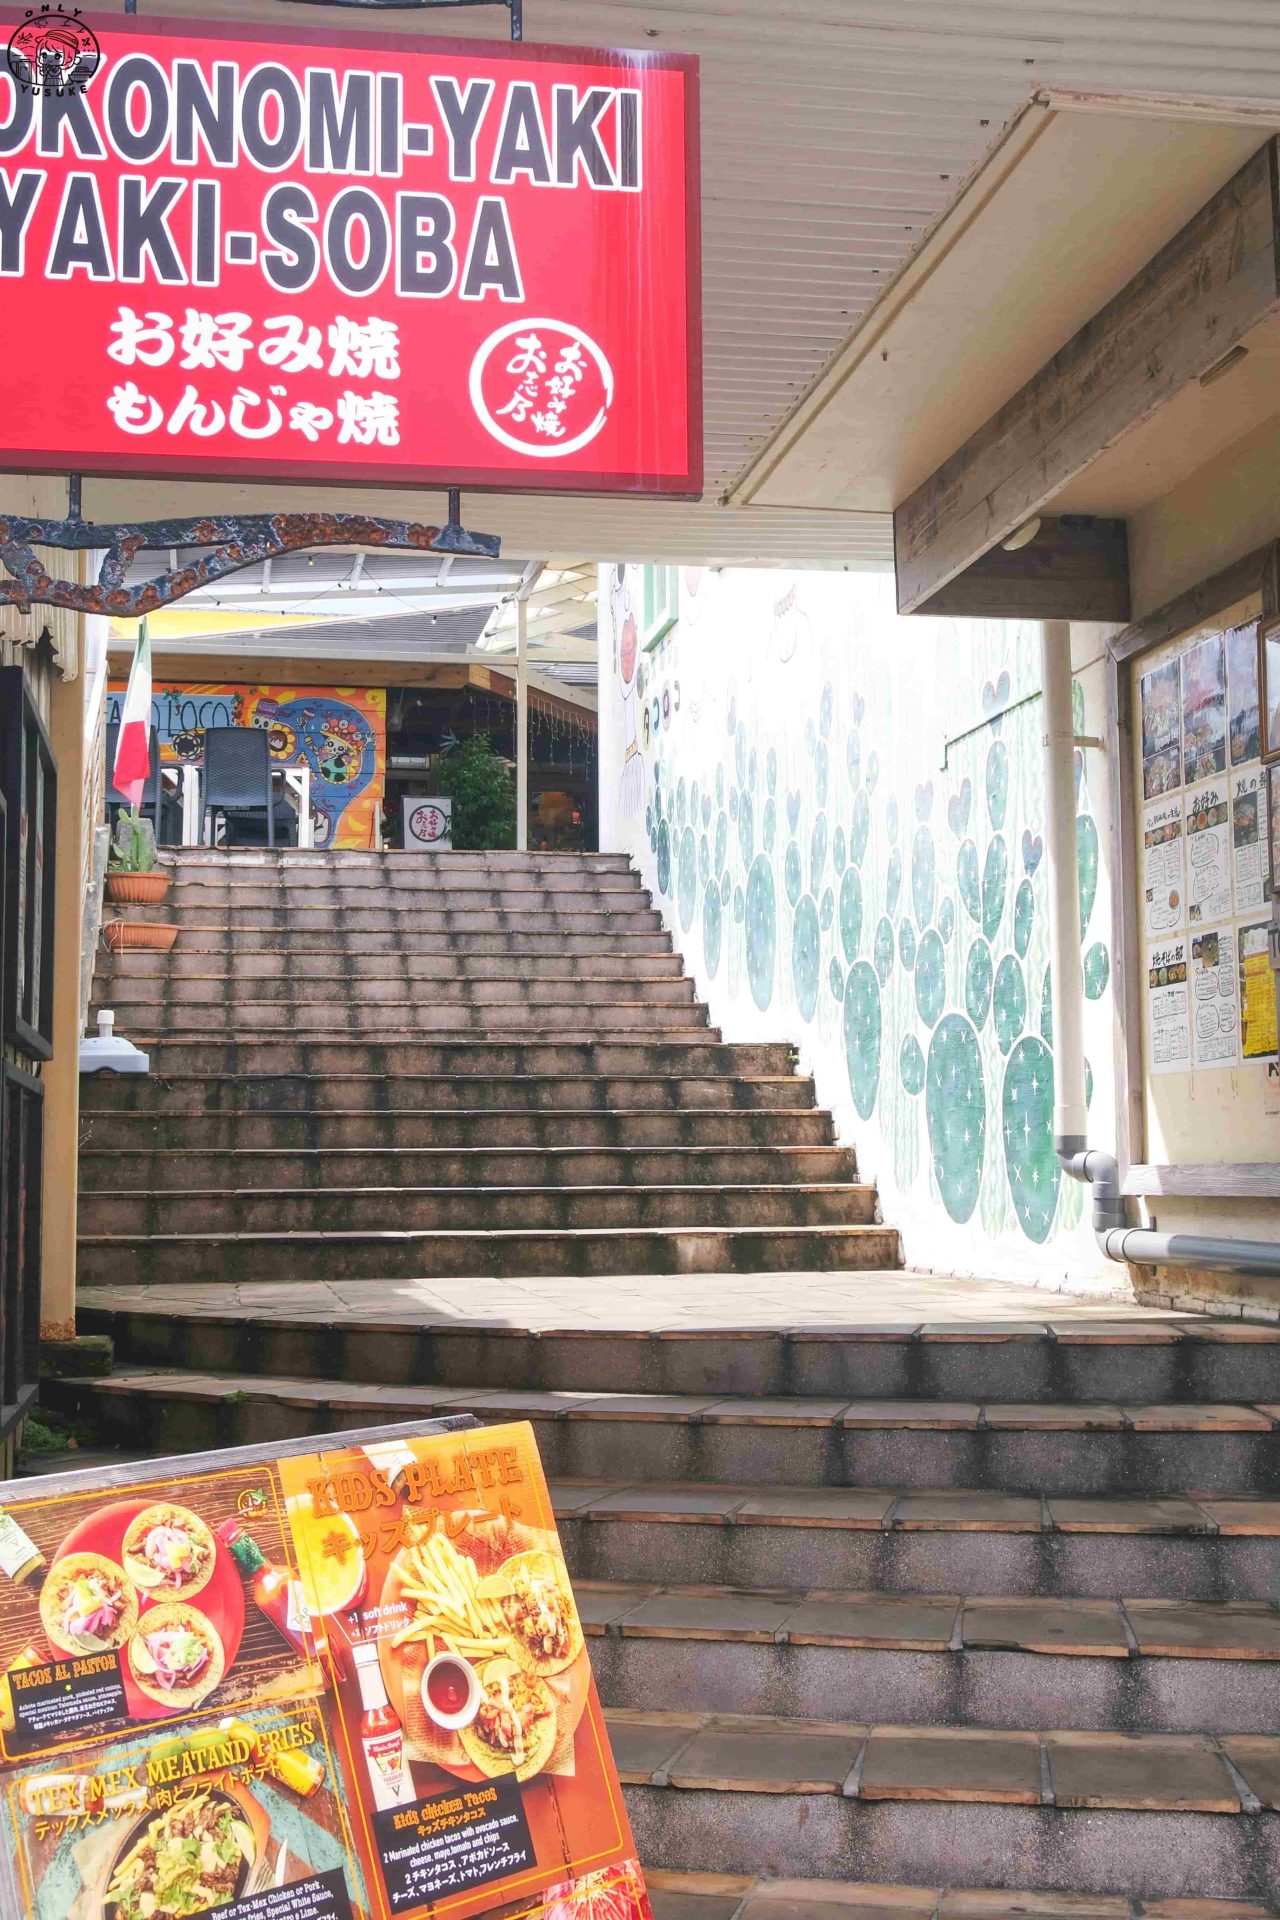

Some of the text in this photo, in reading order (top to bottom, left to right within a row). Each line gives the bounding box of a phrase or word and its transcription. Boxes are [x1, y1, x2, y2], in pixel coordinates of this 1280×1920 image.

[0, 166, 525, 303] YAKI-SOBA
[107, 306, 401, 380] お好み焼
[106, 381, 401, 446] もんじゃ焼
[306, 1448, 523, 1518] KIDS PLATE
[321, 1496, 521, 1566] キッズプレート
[362, 1606, 383, 1620] soft
[383, 1601, 408, 1614] drink
[12, 1654, 118, 1690] TACOS AL PASTOR
[28, 1720, 316, 1817] TEX-MEX MEATAND FRIES
[393, 1810, 420, 1830] Kids
[463, 1787, 498, 1807] Tacos
[417, 1807, 487, 1837] キッズチキンタコス
[383, 1852, 388, 1864] 2
[389, 1843, 420, 1862] Marinated
[420, 1836, 445, 1852] chicken
[445, 1831, 461, 1845] tacos
[462, 1826, 475, 1839] with
[475, 1818, 500, 1835] avocado
[472, 1838, 484, 1848] and
[484, 1831, 501, 1846] chips
[228, 1906, 237, 1917] or
[237, 1898, 268, 1915] Tex-Mex
[268, 1890, 296, 1908] Chicken
[296, 1886, 304, 1896] or
[266, 1901, 292, 1920] Special
[292, 1895, 312, 1909] White
[312, 1889, 334, 1906] Sauce,
[300, 1907, 320, 1919] Lime.
